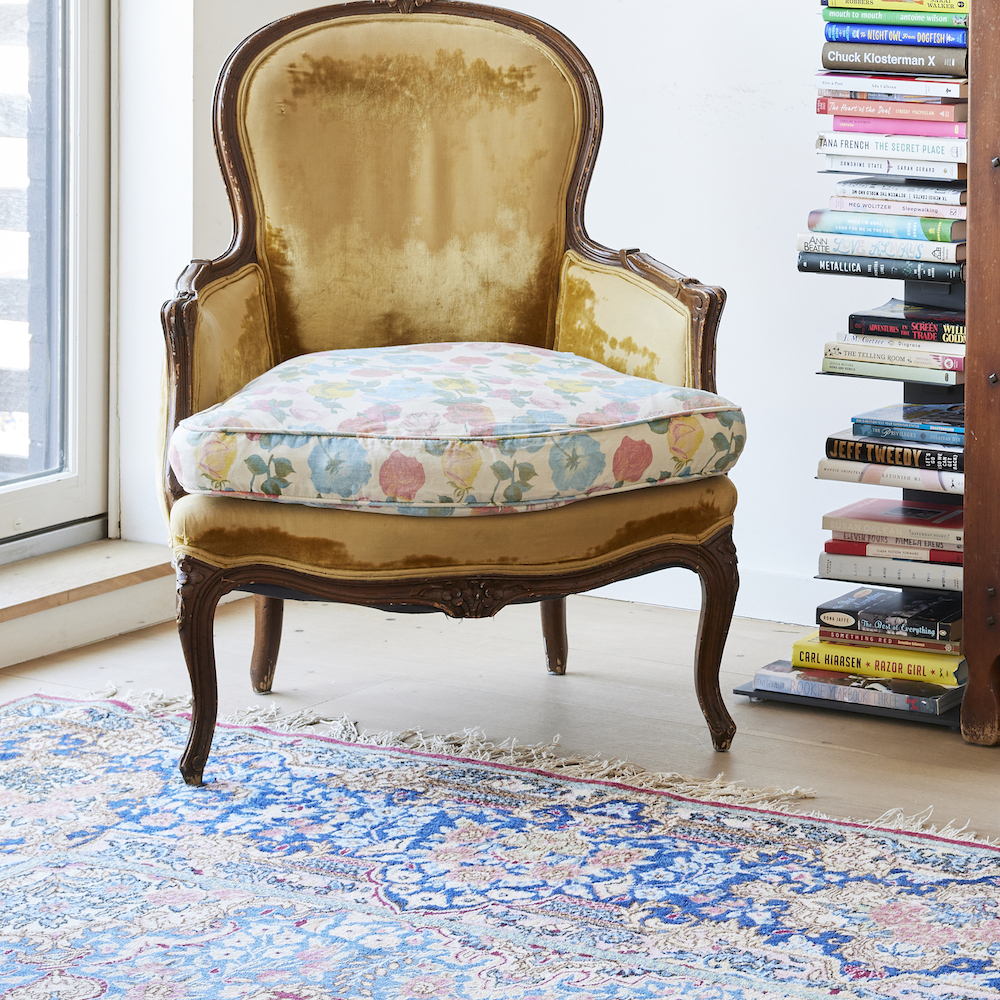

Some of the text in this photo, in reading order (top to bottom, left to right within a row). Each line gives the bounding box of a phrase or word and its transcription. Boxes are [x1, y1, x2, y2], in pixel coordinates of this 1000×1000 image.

[828, 51, 935, 66] Chuck Klosterman X
[820, 139, 945, 154] TANA FRENCH THE SECRET PLACE
[819, 260, 861, 272] METALLICA
[830, 440, 922, 467] JEFF TWEEDY
[861, 620, 873, 629] The
[875, 621, 890, 630] Best
[901, 624, 935, 636] Everything
[800, 650, 926, 676] CARL HIAASEN RAZOR GIRL
